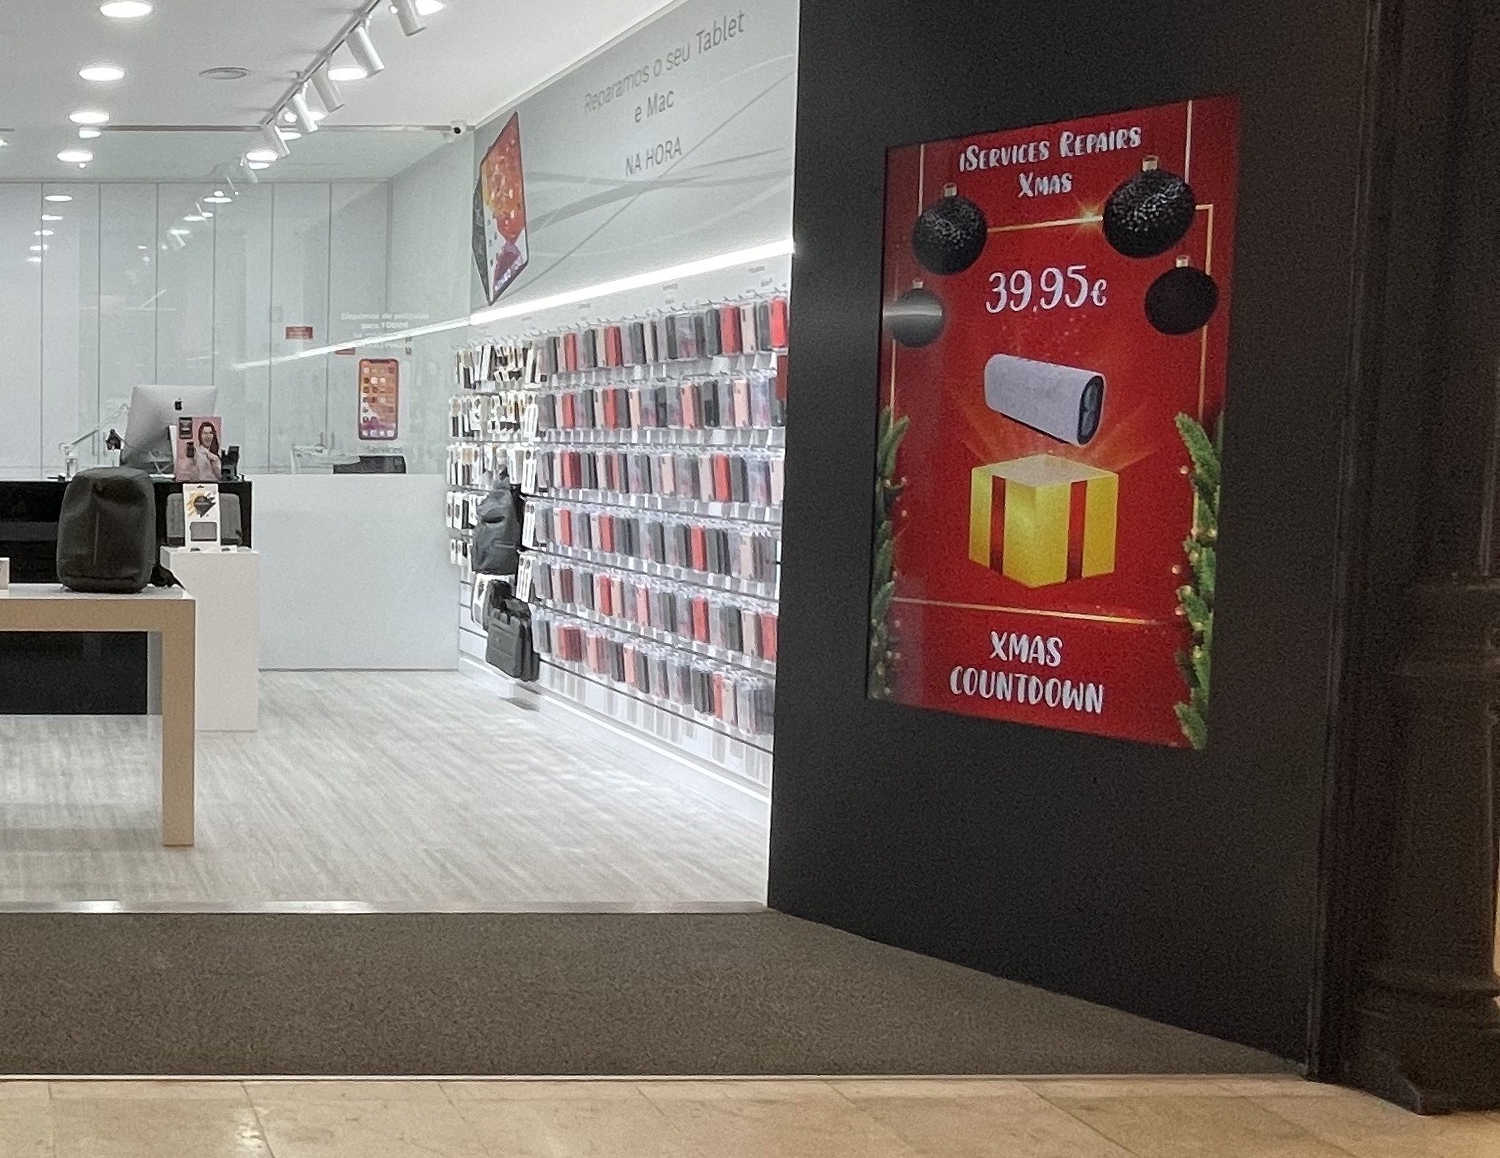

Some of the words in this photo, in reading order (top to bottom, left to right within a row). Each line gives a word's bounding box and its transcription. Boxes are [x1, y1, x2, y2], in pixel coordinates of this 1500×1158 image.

[584, 65, 650, 115] Reparamos
[653, 58, 662, 77] o
[666, 44, 690, 71] seu
[696, 10, 744, 54] Tablet
[634, 106, 642, 123] e
[647, 90, 674, 118] Mac
[626, 153, 642, 177] NA
[645, 136, 682, 170] HORA
[989, 631, 1063, 667] XMAS
[950, 666, 1104, 714] COUNTDOWN
